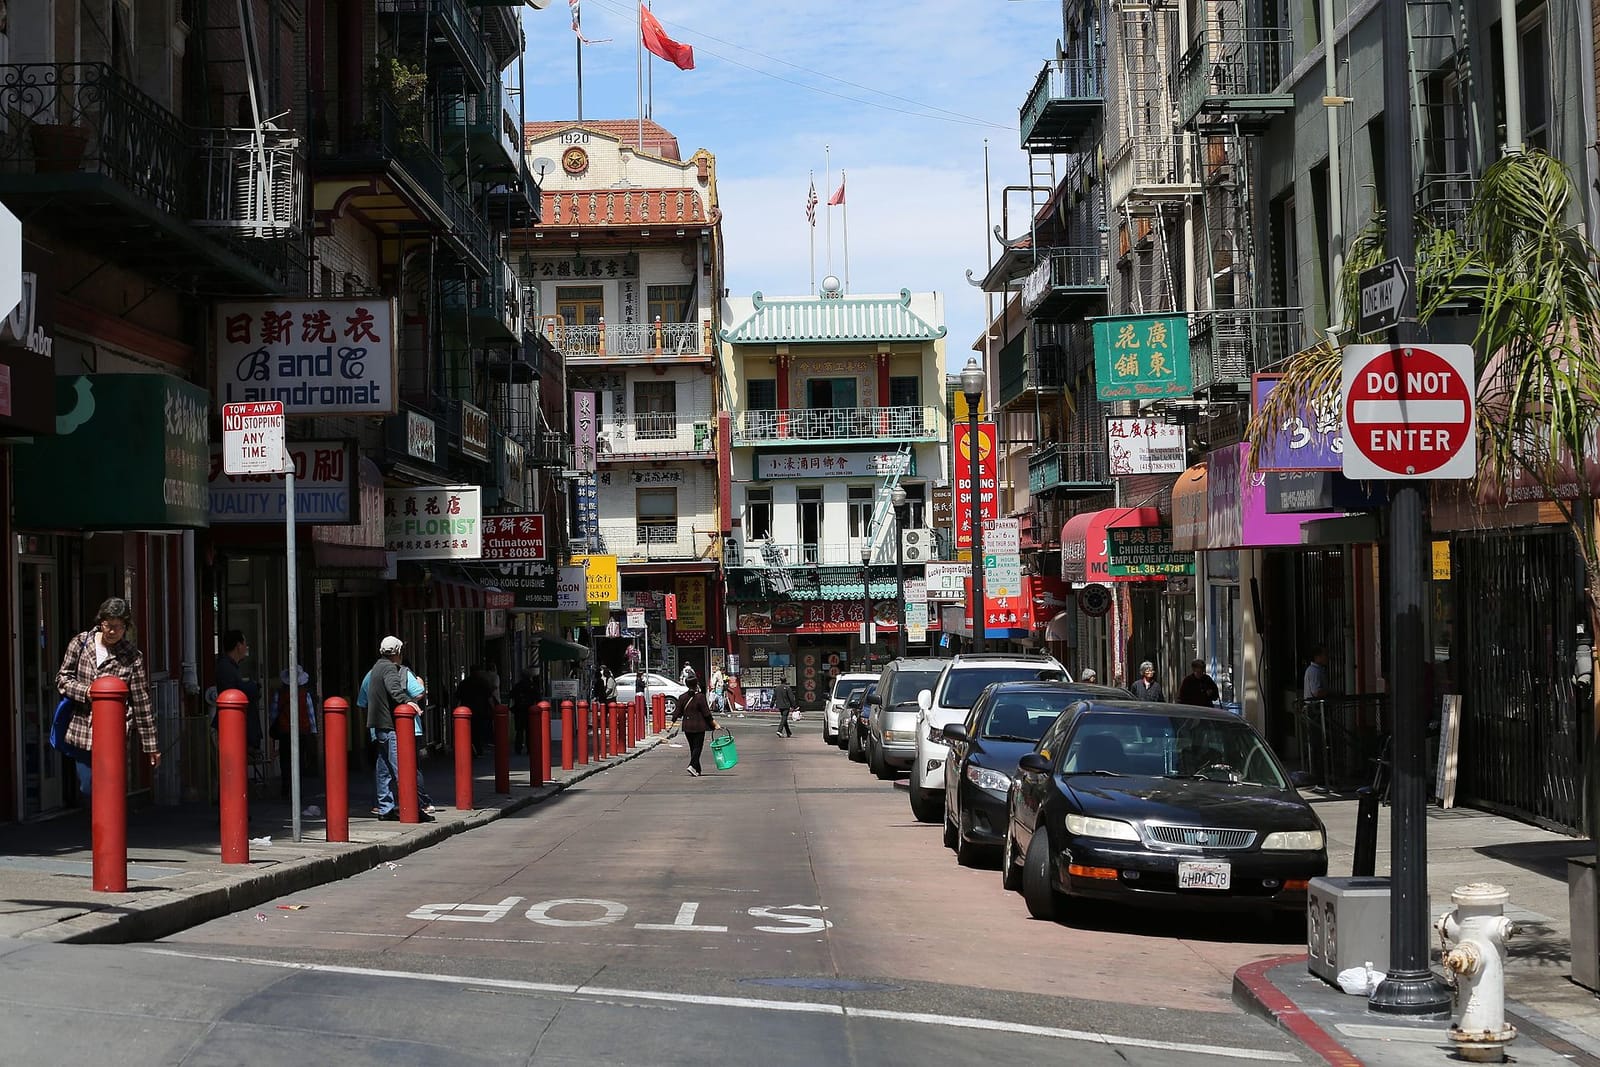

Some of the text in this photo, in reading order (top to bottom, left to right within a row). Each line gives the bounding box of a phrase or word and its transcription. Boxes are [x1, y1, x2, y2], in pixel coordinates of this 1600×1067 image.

[561, 134, 589, 144] 1920
[1363, 281, 1394, 313] ONE WAY
[225, 307, 380, 345] 日新洗衣
[278, 346, 332, 376] and
[1367, 372, 1452, 394] DO NOT
[226, 380, 380, 405] Laundromat
[229, 405, 246, 414] TOW
[253, 404, 277, 413] AWAY
[226, 415, 281, 430] NO STOPPING
[243, 432, 265, 445] ANY
[1370, 429, 1451, 451] ENTER
[242, 446, 267, 458] TIME
[959, 480, 994, 488] BOING
[279, 492, 348, 513] PINTING
[960, 494, 994, 502] SHMP
[405, 519, 475, 535] FLORIST
[996, 522, 1018, 530] PARKING
[489, 538, 543, 548] Chinatown
[1119, 545, 1155, 555] CHINESE
[987, 557, 994, 567] 2
[1110, 554, 1195, 565] EMPLOYMENT AGENC
[928, 568, 941, 577] Lucky
[942, 566, 957, 574] Dragon
[480, 578, 545, 588] HONG KONG CUISINE
[1182, 872, 1227, 886] 4HDA178
[406, 896, 834, 934] STOP
